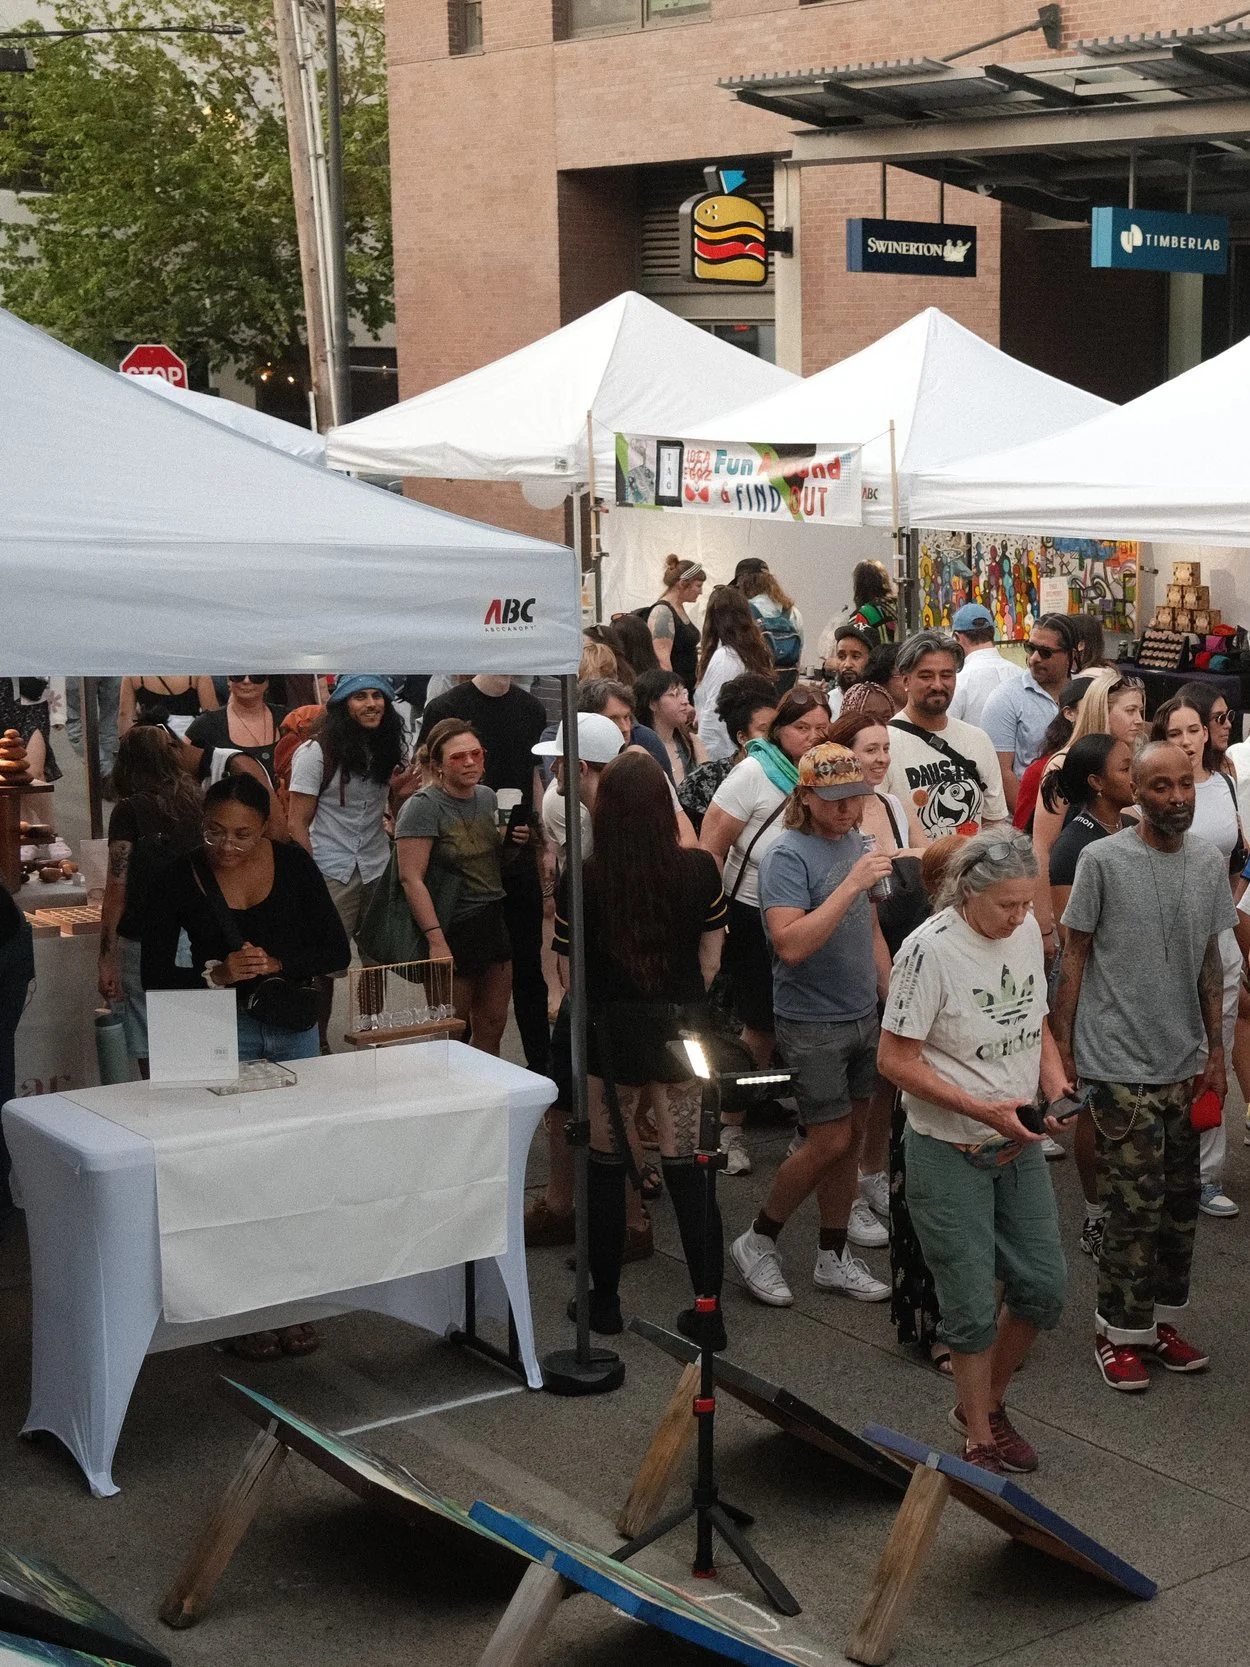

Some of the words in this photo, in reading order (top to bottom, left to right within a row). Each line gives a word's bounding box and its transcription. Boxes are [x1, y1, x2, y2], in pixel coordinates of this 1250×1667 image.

[867, 237, 943, 257] SWINERTON
[1145, 233, 1221, 251] TIMBERLAB
[126, 366, 183, 385] OP
[714, 449, 754, 476] Fun
[736, 483, 782, 513] FIND
[789, 485, 828, 517] OUT
[862, 487, 879, 501] ABC
[483, 597, 537, 625] ABC
